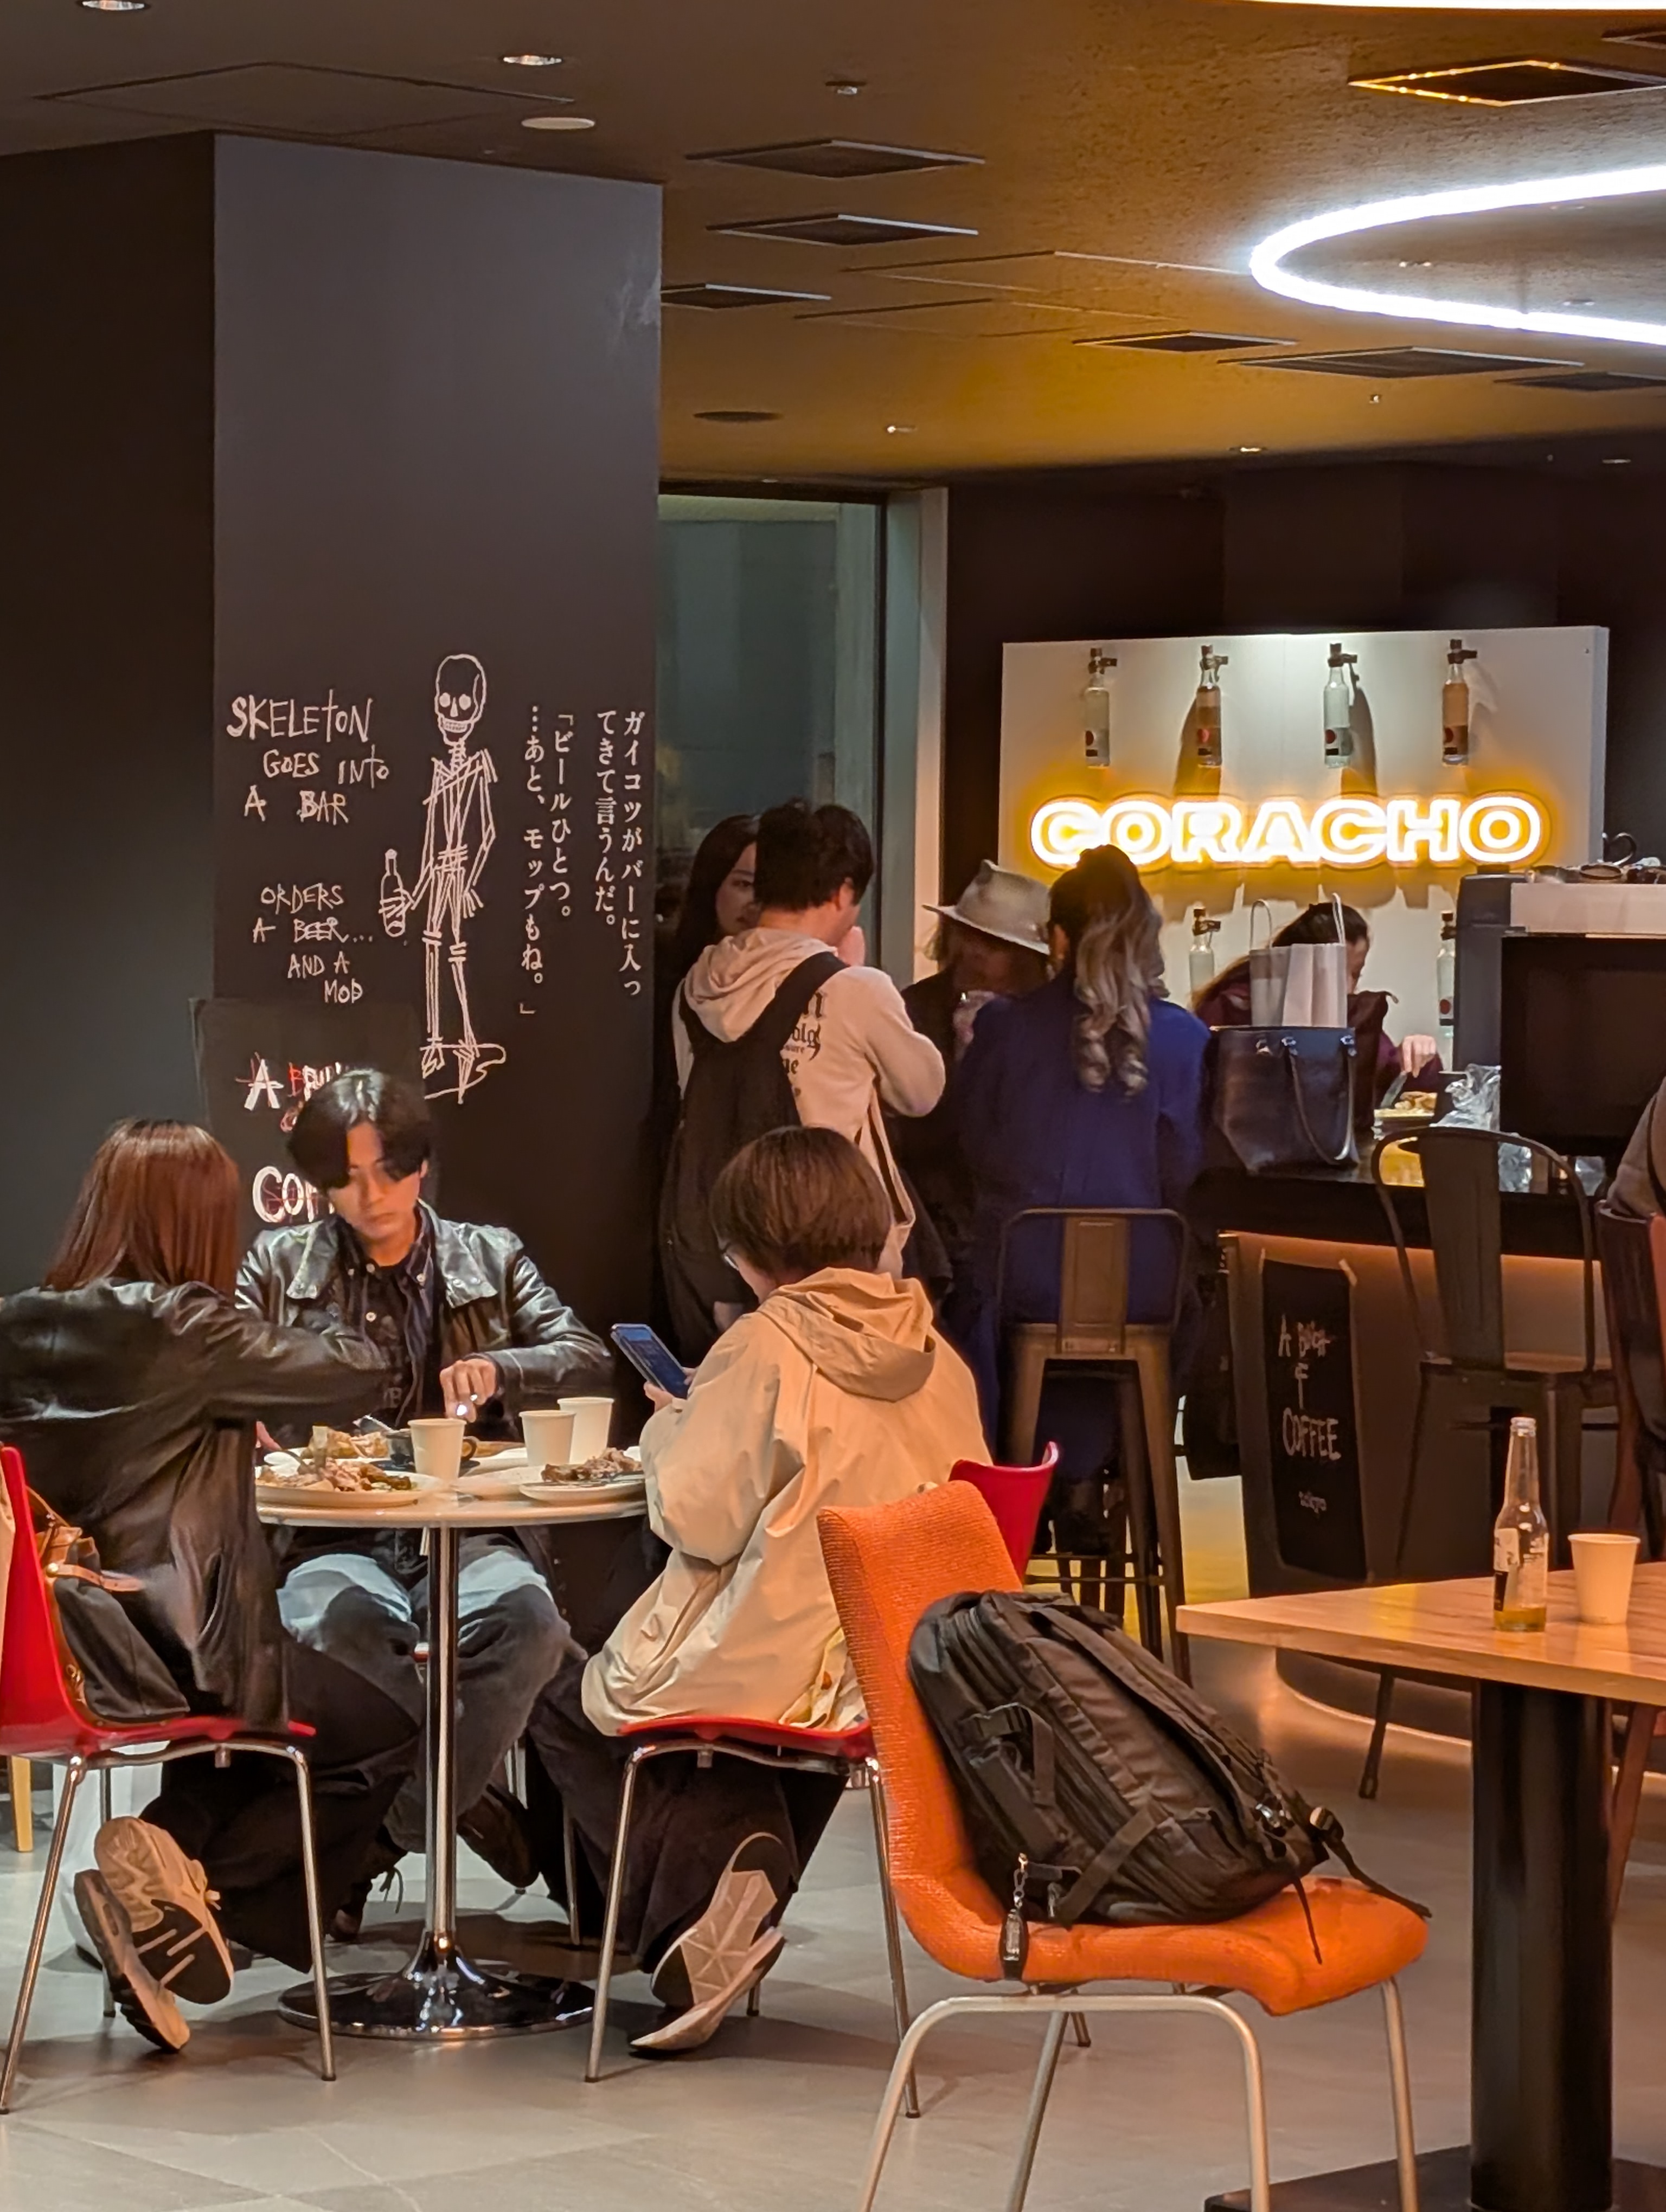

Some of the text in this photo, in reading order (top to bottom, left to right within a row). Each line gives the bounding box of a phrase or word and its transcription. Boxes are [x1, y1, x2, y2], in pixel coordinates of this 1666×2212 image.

[263, 749, 319, 778] GOES
[244, 785, 349, 826] A BAR
[595, 710, 617, 925] てきて言うんだ。
[619, 711, 645, 995] ガイコツがバーに入っ
[1029, 795, 1542, 867] CORACHO
[260, 883, 344, 915] ORDERS
[252, 917, 276, 943] A
[287, 950, 350, 979] AND A
[240, 1055, 284, 1111] A
[1282, 1407, 1342, 1461] COFFEE
